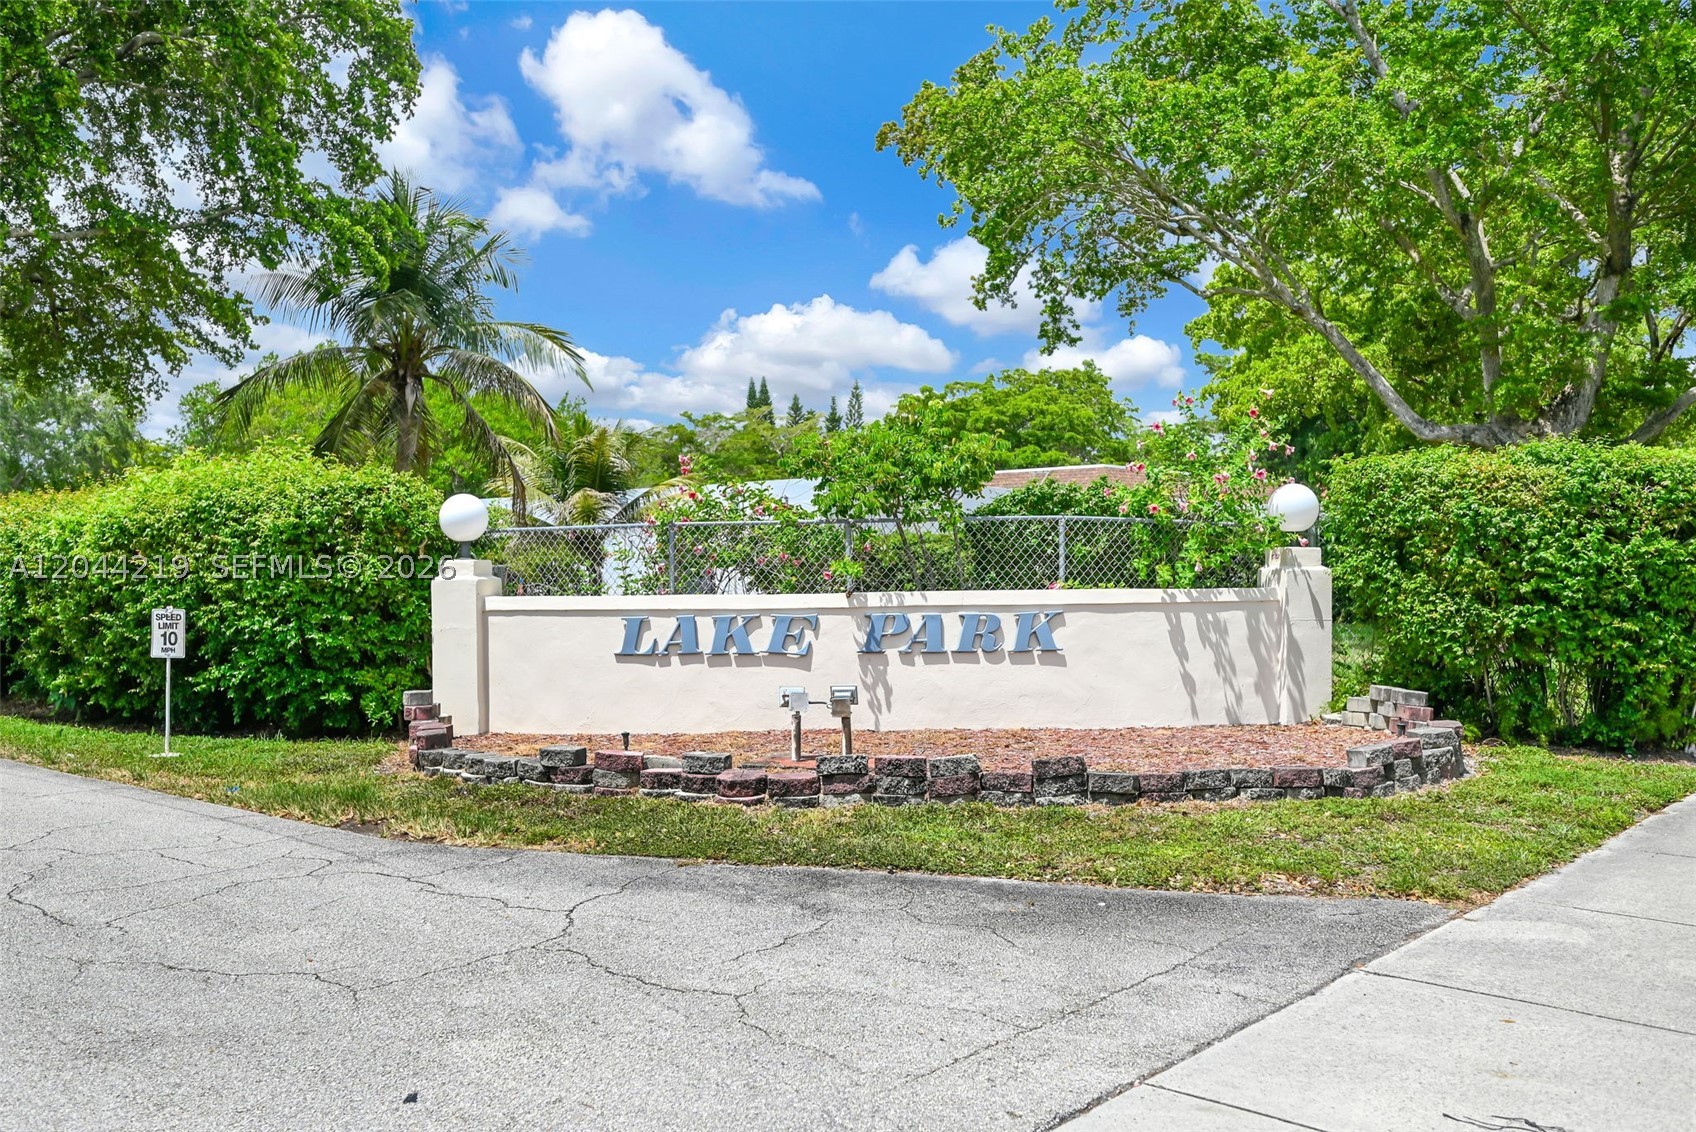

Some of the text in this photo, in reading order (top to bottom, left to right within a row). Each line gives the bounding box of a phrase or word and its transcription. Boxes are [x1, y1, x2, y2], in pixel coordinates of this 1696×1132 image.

[155, 613, 182, 621] SPEED
[158, 622, 179, 630] LIMIT
[614, 609, 1065, 656] LAKE PARK
[160, 631, 178, 646] 10
